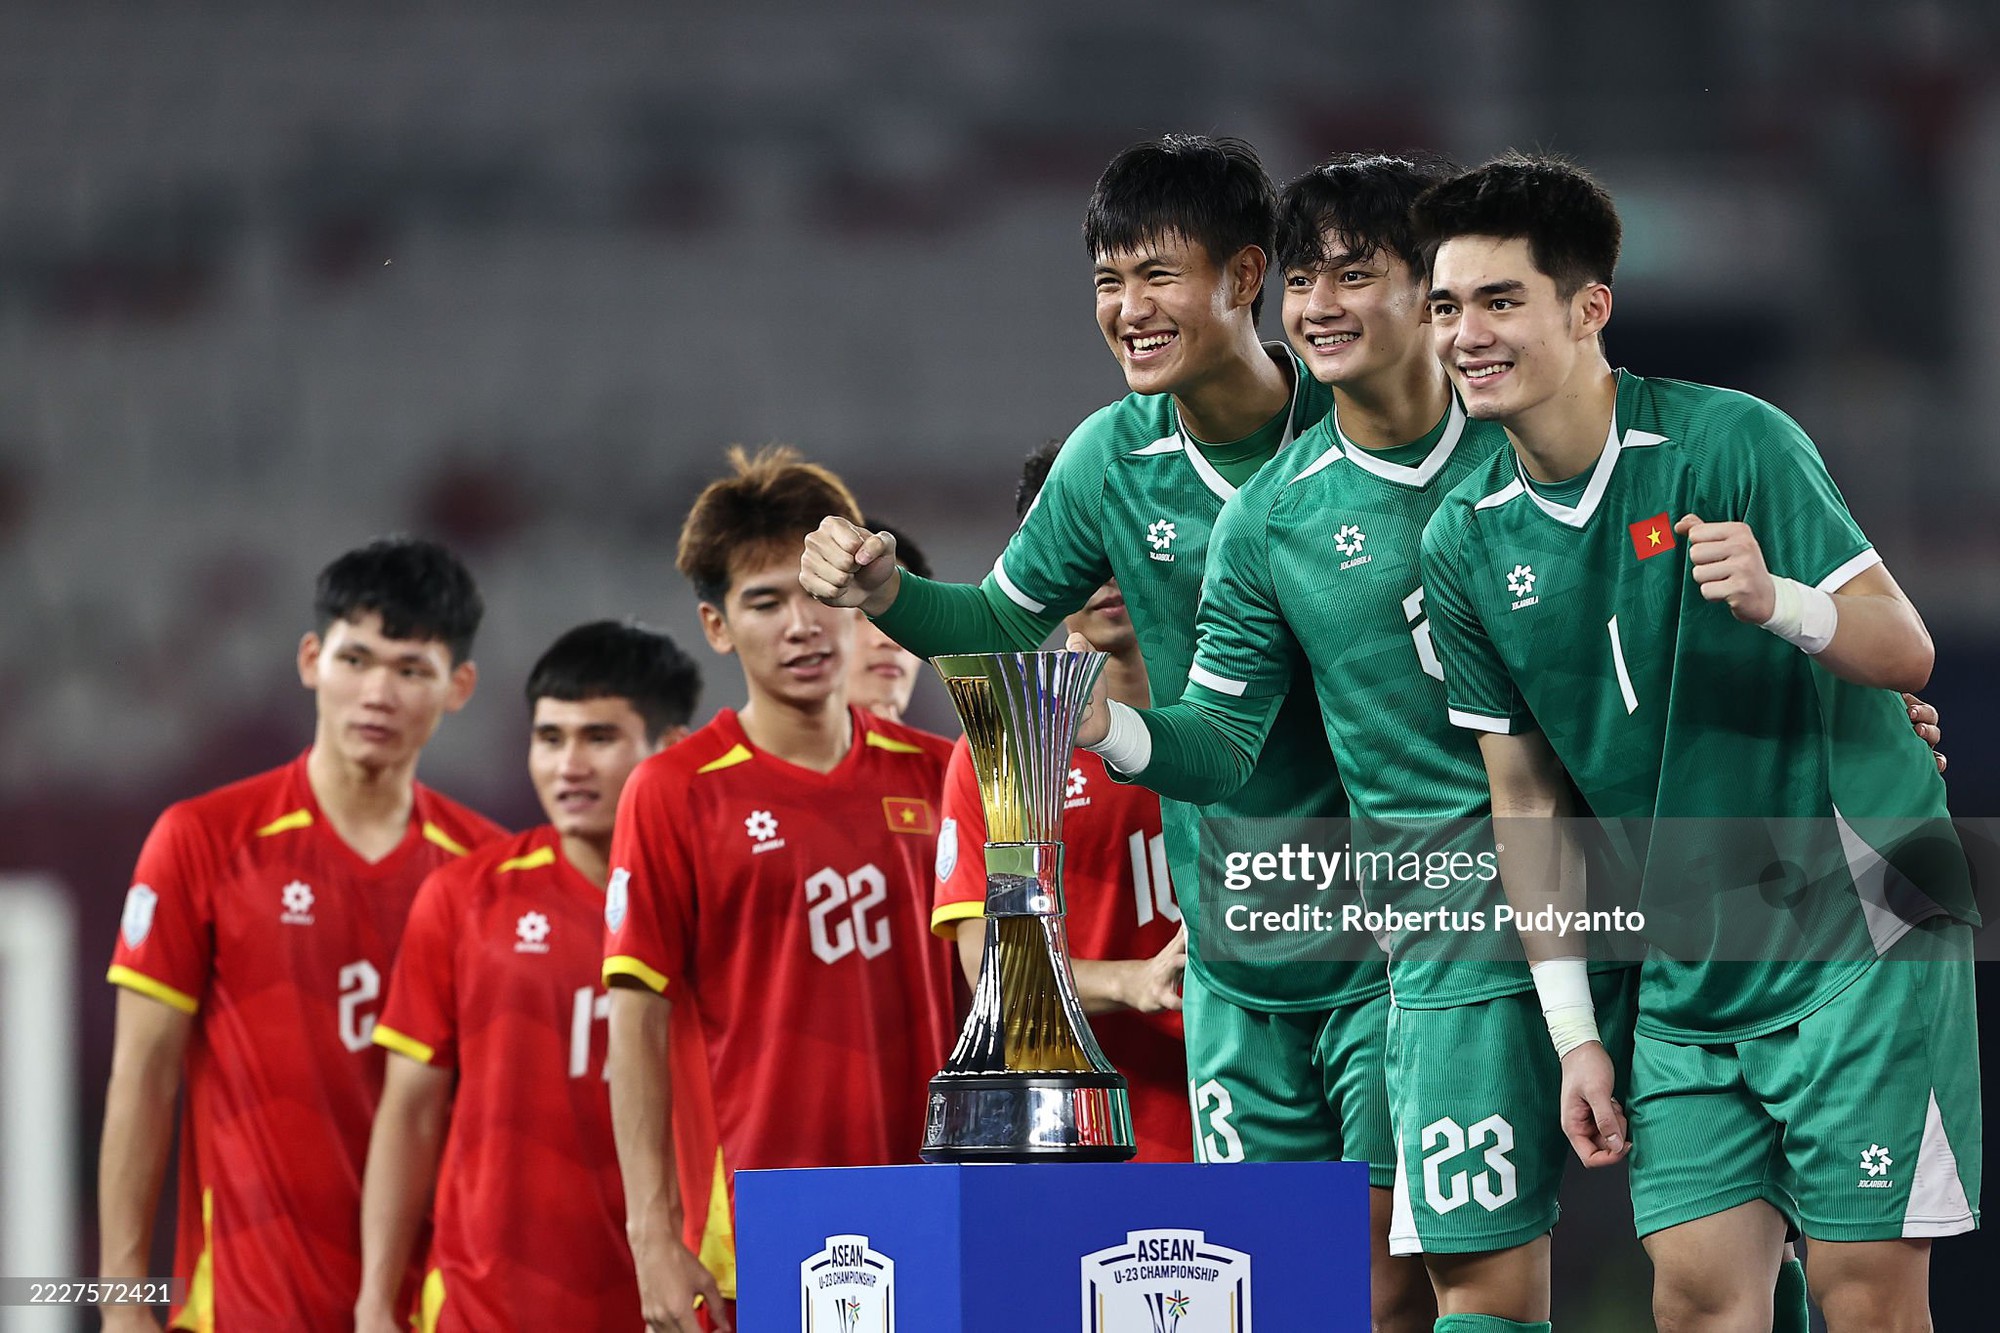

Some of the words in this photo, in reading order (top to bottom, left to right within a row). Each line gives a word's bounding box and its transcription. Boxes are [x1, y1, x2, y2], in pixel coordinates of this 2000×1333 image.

[805, 863, 892, 965] 22
[1421, 1113, 1518, 1216] 23
[831, 1245, 863, 1268] ASEAN
[1137, 1239, 1195, 1262] ASEAN
[819, 1273, 833, 1289] U-23
[834, 1271, 877, 1287] CHAMPIONSHIP
[1114, 1267, 1139, 1284] U-23
[1141, 1265, 1219, 1282] CHAMPIONSHIP
